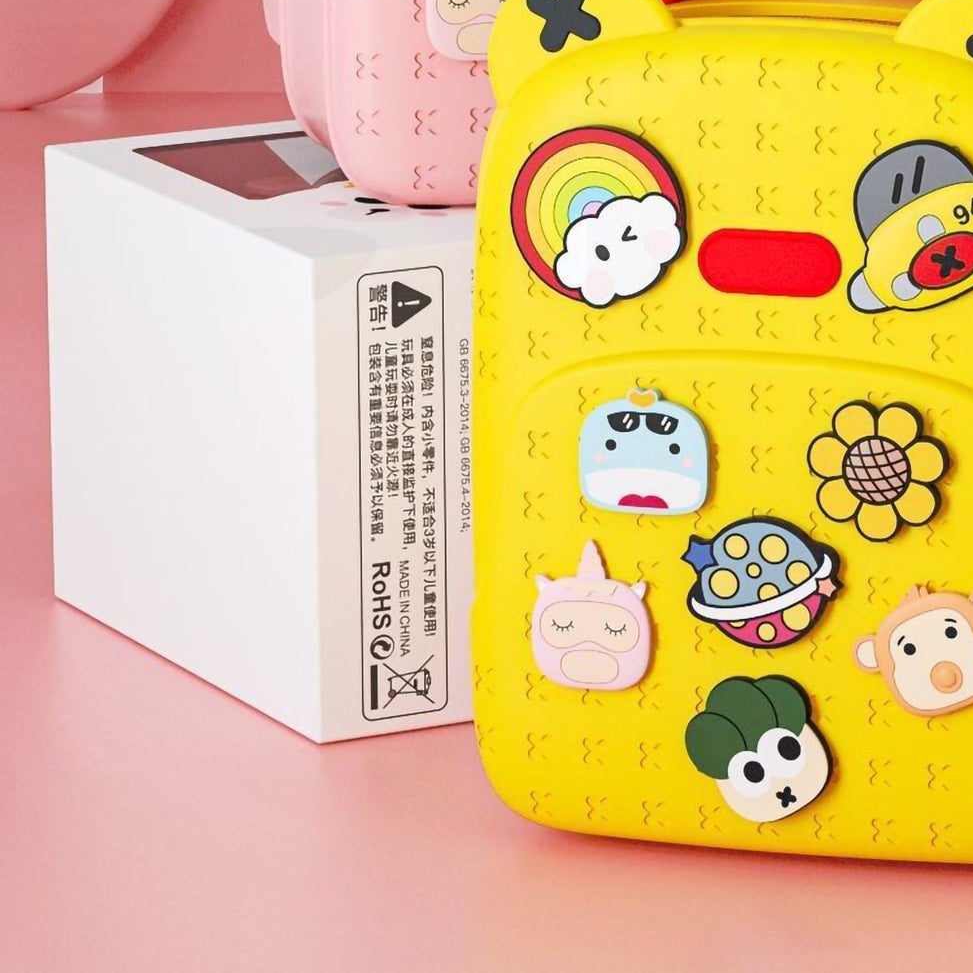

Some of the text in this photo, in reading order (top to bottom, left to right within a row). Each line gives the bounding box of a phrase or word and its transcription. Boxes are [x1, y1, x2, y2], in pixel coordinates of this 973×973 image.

[368, 283, 388, 332] 警告！
[459, 338, 469, 355] GB
[459, 358, 470, 434] 6675.3-2014;
[459, 437, 470, 453] GB
[371, 561, 391, 629] RoHS
[398, 560, 411, 657] MADE IN CHINA
